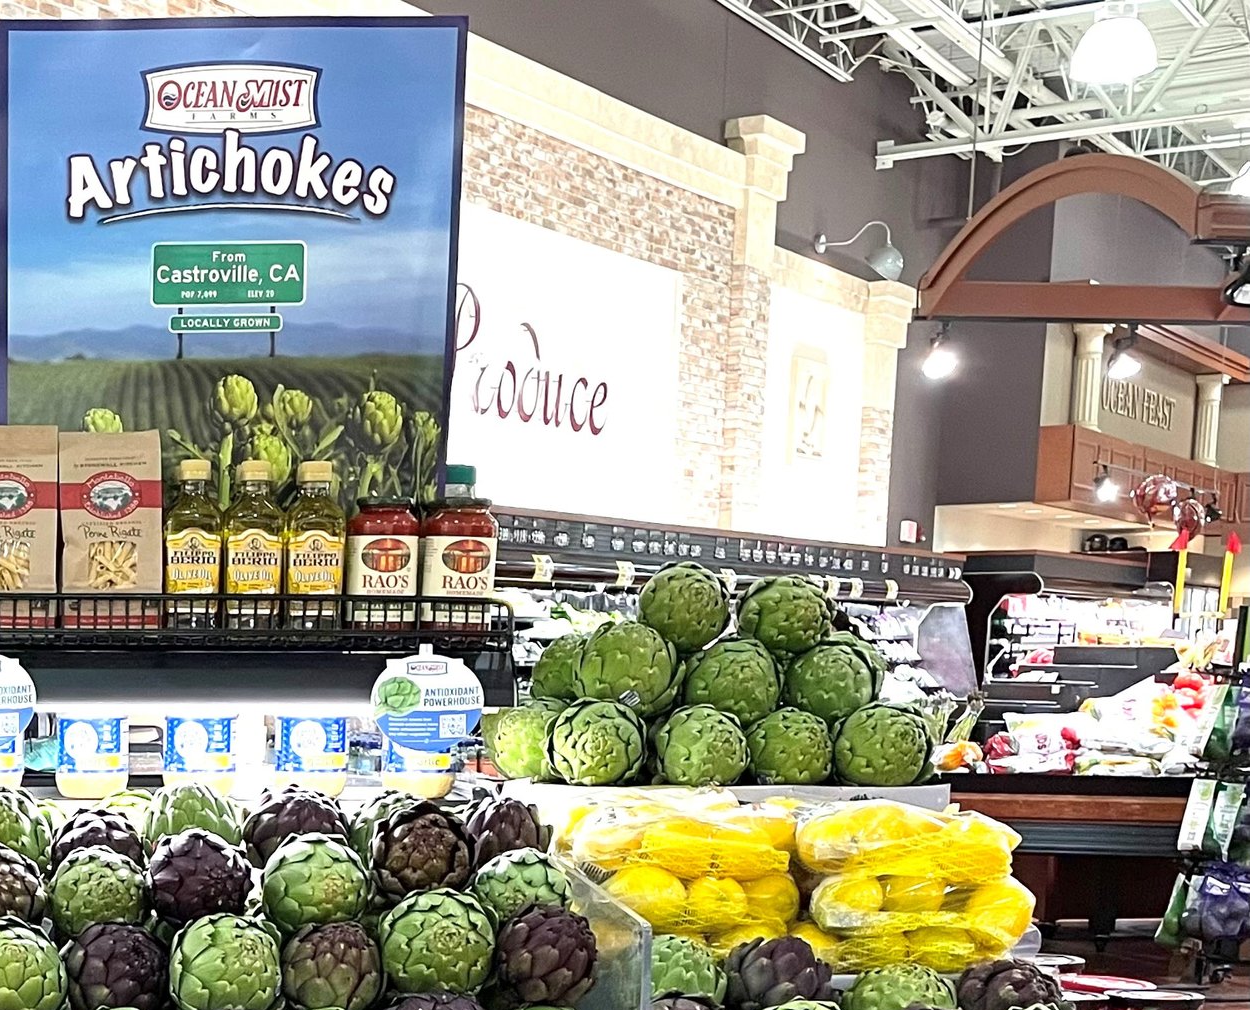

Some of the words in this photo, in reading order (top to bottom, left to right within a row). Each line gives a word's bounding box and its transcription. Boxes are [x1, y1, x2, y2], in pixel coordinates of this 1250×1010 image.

[158, 80, 237, 111] OCEAN
[235, 79, 307, 113] MIST
[192, 112, 277, 121] FARMS
[67, 130, 395, 218] Artichokes
[212, 251, 246, 262] From
[156, 265, 263, 286] Castroville,
[269, 264, 300, 282] CA
[181, 291, 196, 299] POP
[248, 290, 263, 298] ELEV
[266, 290, 274, 298] 20
[181, 319, 230, 328] LOCALLY
[233, 318, 270, 327] GROWN
[1102, 375, 1140, 419] OCEAN
[1141, 388, 1177, 431] FEAST
[171, 556, 216, 564] BERIO
[232, 558, 278, 566] BERIO
[293, 559, 339, 567] BERIO
[362, 575, 409, 588] RAO'S
[442, 575, 488, 590] RAO'S
[425, 686, 479, 697] ANTIOXIDANT
[424, 696, 480, 706] POWERHOUSE
